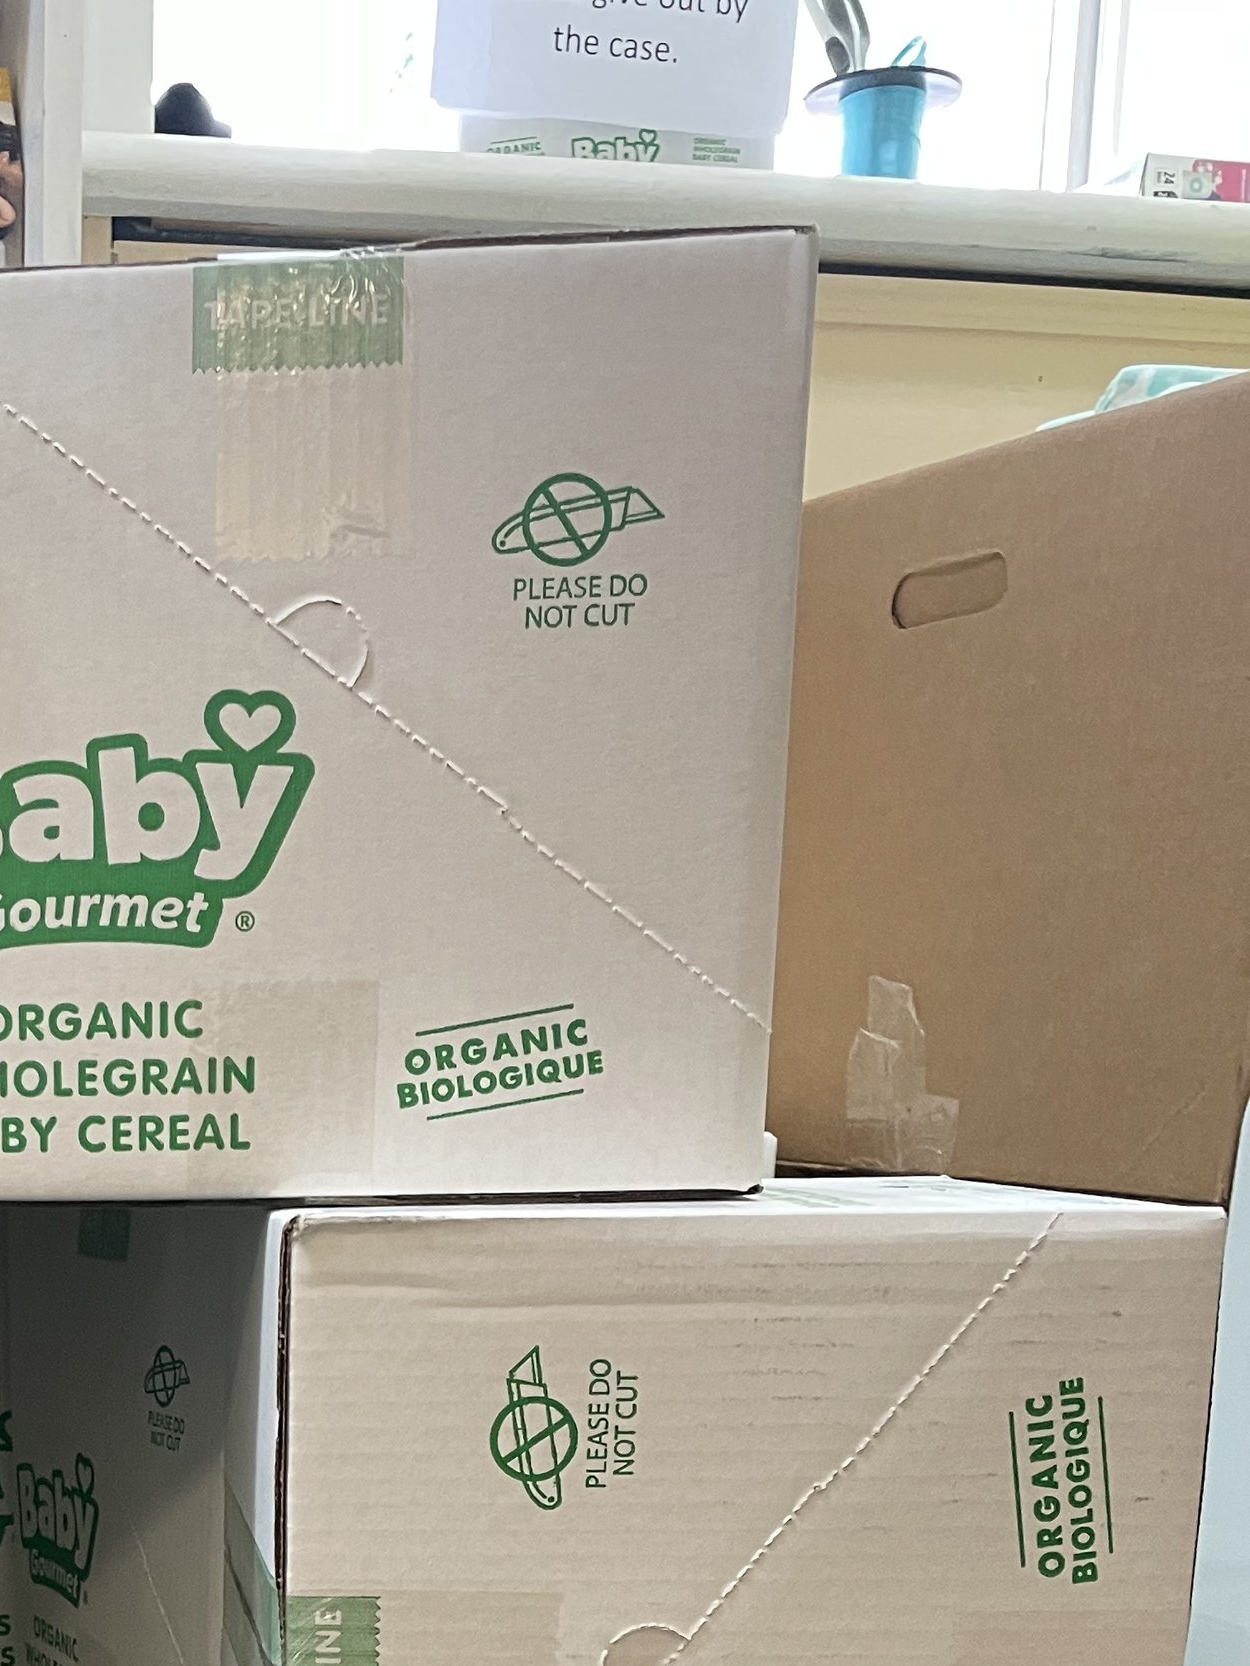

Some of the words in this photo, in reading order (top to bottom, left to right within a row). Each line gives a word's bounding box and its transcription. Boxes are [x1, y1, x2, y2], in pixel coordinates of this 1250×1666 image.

[553, 24, 599, 55] the
[609, 37, 678, 63] case.
[571, 136, 660, 162] Baby
[513, 574, 602, 601] PLEASE
[608, 572, 649, 598] DO
[524, 604, 578, 630] NOT
[583, 602, 636, 628] CUT
[403, 1018, 590, 1077] ORGANIC
[396, 1050, 605, 1110] BIOLOGIQUE
[76, 1112, 252, 1154] CEREAL
[589, 1357, 614, 1397] DO
[613, 1369, 640, 1420] CUT
[584, 1401, 612, 1490] PLEASE
[611, 1421, 638, 1477] NOT
[1027, 1394, 1065, 1579] ORGANIC
[1062, 1375, 1101, 1586] BIOLOGIQUE
